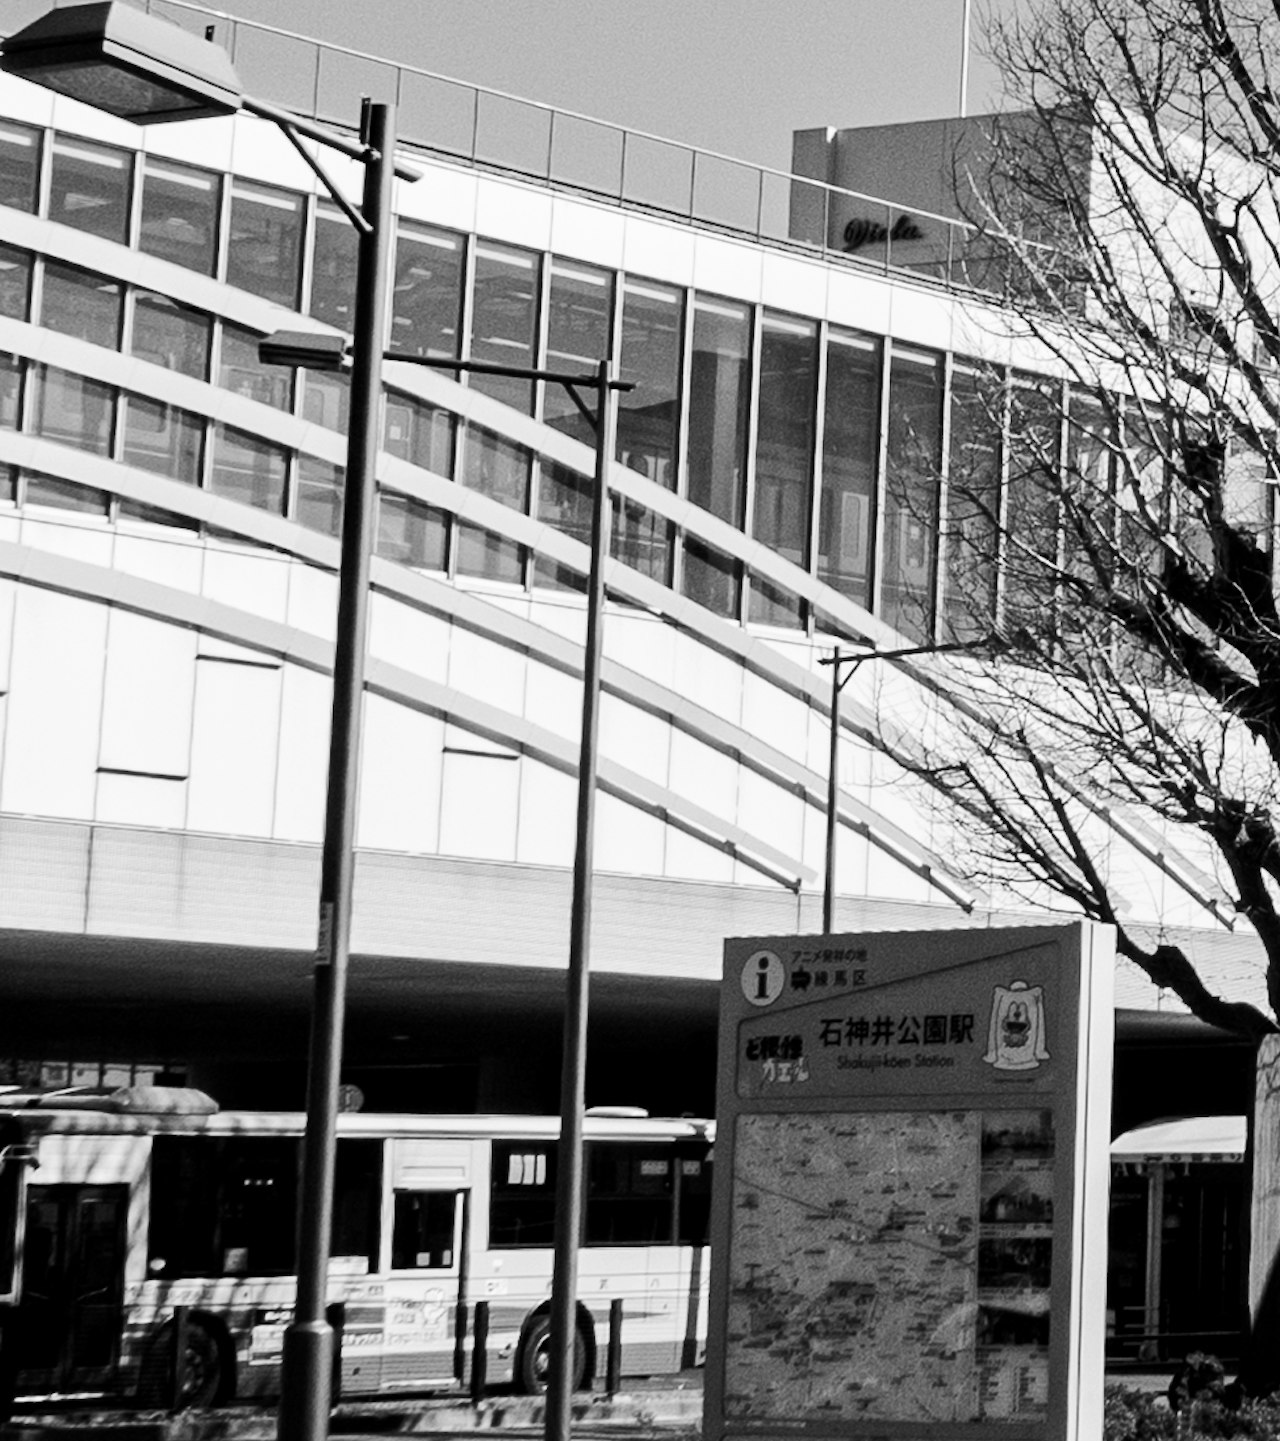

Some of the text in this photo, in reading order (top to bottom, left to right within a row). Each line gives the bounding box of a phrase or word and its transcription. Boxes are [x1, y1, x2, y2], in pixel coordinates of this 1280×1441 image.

[792, 949, 867, 963] アニメ発祥の地
[814, 970, 867, 986] 練馬区
[820, 1013, 975, 1047] 石神井公園駅
[914, 1053, 954, 1068] Station
